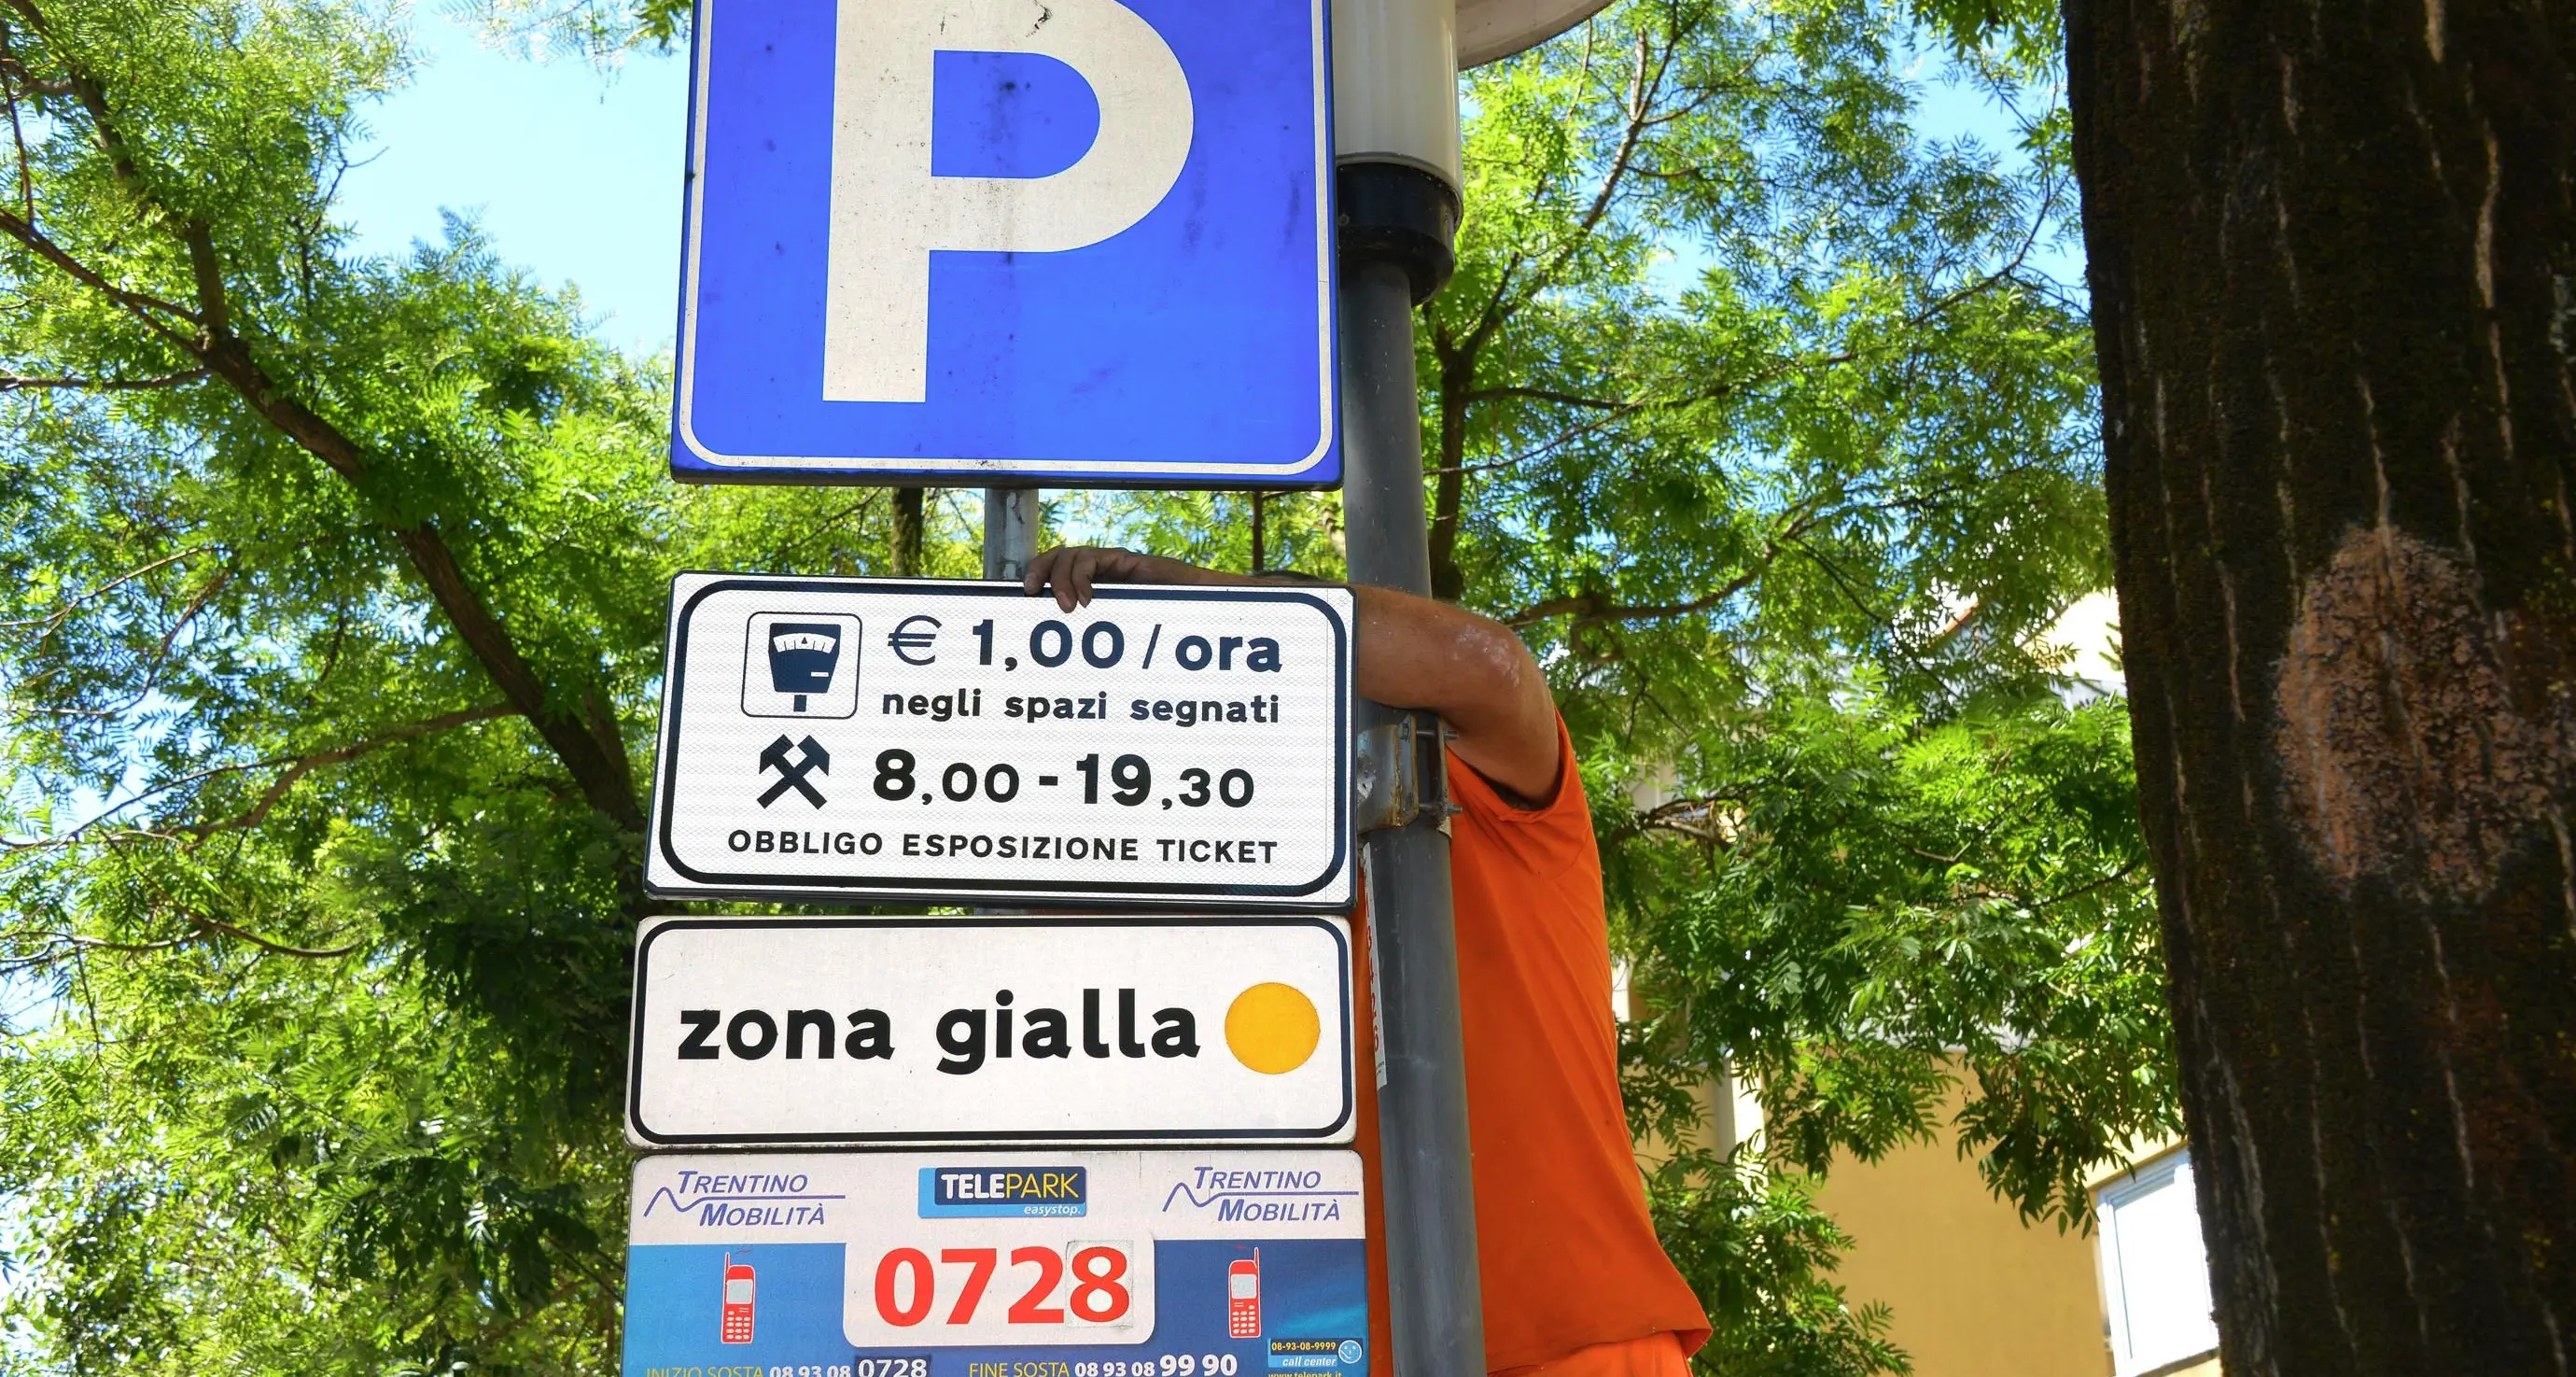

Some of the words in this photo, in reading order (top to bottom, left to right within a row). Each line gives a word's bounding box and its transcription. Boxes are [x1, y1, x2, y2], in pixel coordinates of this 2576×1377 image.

[822, 0, 1194, 403] P
[888, 614, 943, 667] €
[972, 619, 1125, 672] 1,00
[1175, 634, 1283, 673] ora
[882, 687, 982, 723] negli
[1003, 691, 1107, 724] spazi
[1129, 694, 1280, 727] segnati
[873, 748, 1020, 806] 8,00
[1076, 753, 1255, 810] 19,30
[728, 829, 883, 856] OBBLIGO
[903, 834, 1139, 861] ESPOSIZIONE
[1155, 838, 1278, 864] TICKET
[678, 1008, 895, 1061] zona
[936, 988, 1201, 1075] gialla
[678, 1170, 808, 1194] TRENTINO
[941, 1173, 1079, 1200] TELEPARK
[1194, 1166, 1322, 1189] TRENTINO
[699, 1202, 825, 1227] MOBILITÀ
[1024, 1203, 1081, 1217] easystop.
[1217, 1199, 1340, 1222] MOBILITÀ
[874, 1245, 1130, 1328] 0728
[1271, 1342, 1337, 1351] 08-93-08-9999
[646, 1367, 703, 1377] INIZIO
[707, 1366, 764, 1377] SOSTA
[769, 1366, 793, 1377] 08
[798, 1365, 822, 1377] 93
[827, 1365, 851, 1377] 08
[858, 1358, 928, 1377] 0728
[970, 1362, 1009, 1377] FINE
[1014, 1361, 1071, 1377] SOSTA
[1074, 1361, 1099, 1377] 08
[1102, 1361, 1127, 1377] 93
[1131, 1361, 1156, 1377] 08
[1159, 1355, 1196, 1377] 99
[1201, 1354, 1239, 1377] 90
[1282, 1356, 1302, 1367] call
[1304, 1356, 1337, 1367] center
